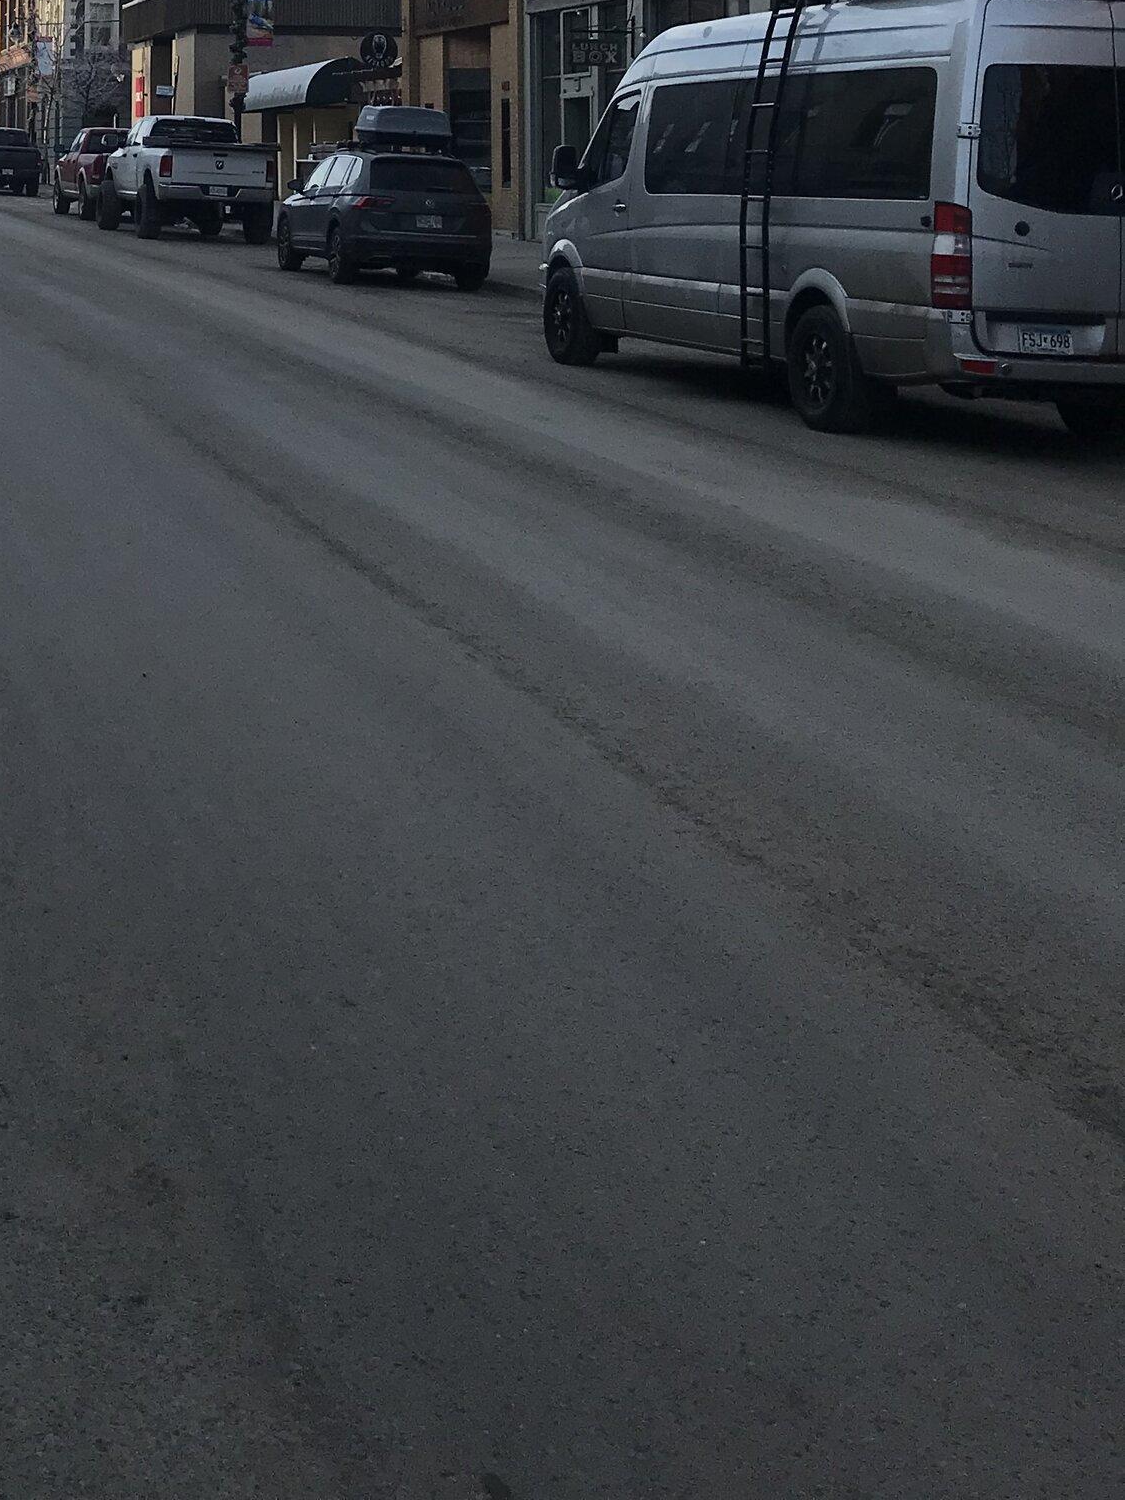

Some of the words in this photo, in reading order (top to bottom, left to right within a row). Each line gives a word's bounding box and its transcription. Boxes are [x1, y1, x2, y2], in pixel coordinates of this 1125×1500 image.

[572, 43, 617, 51] LUNCH
[572, 51, 617, 63] BOX
[1050, 334, 1070, 348] 698
